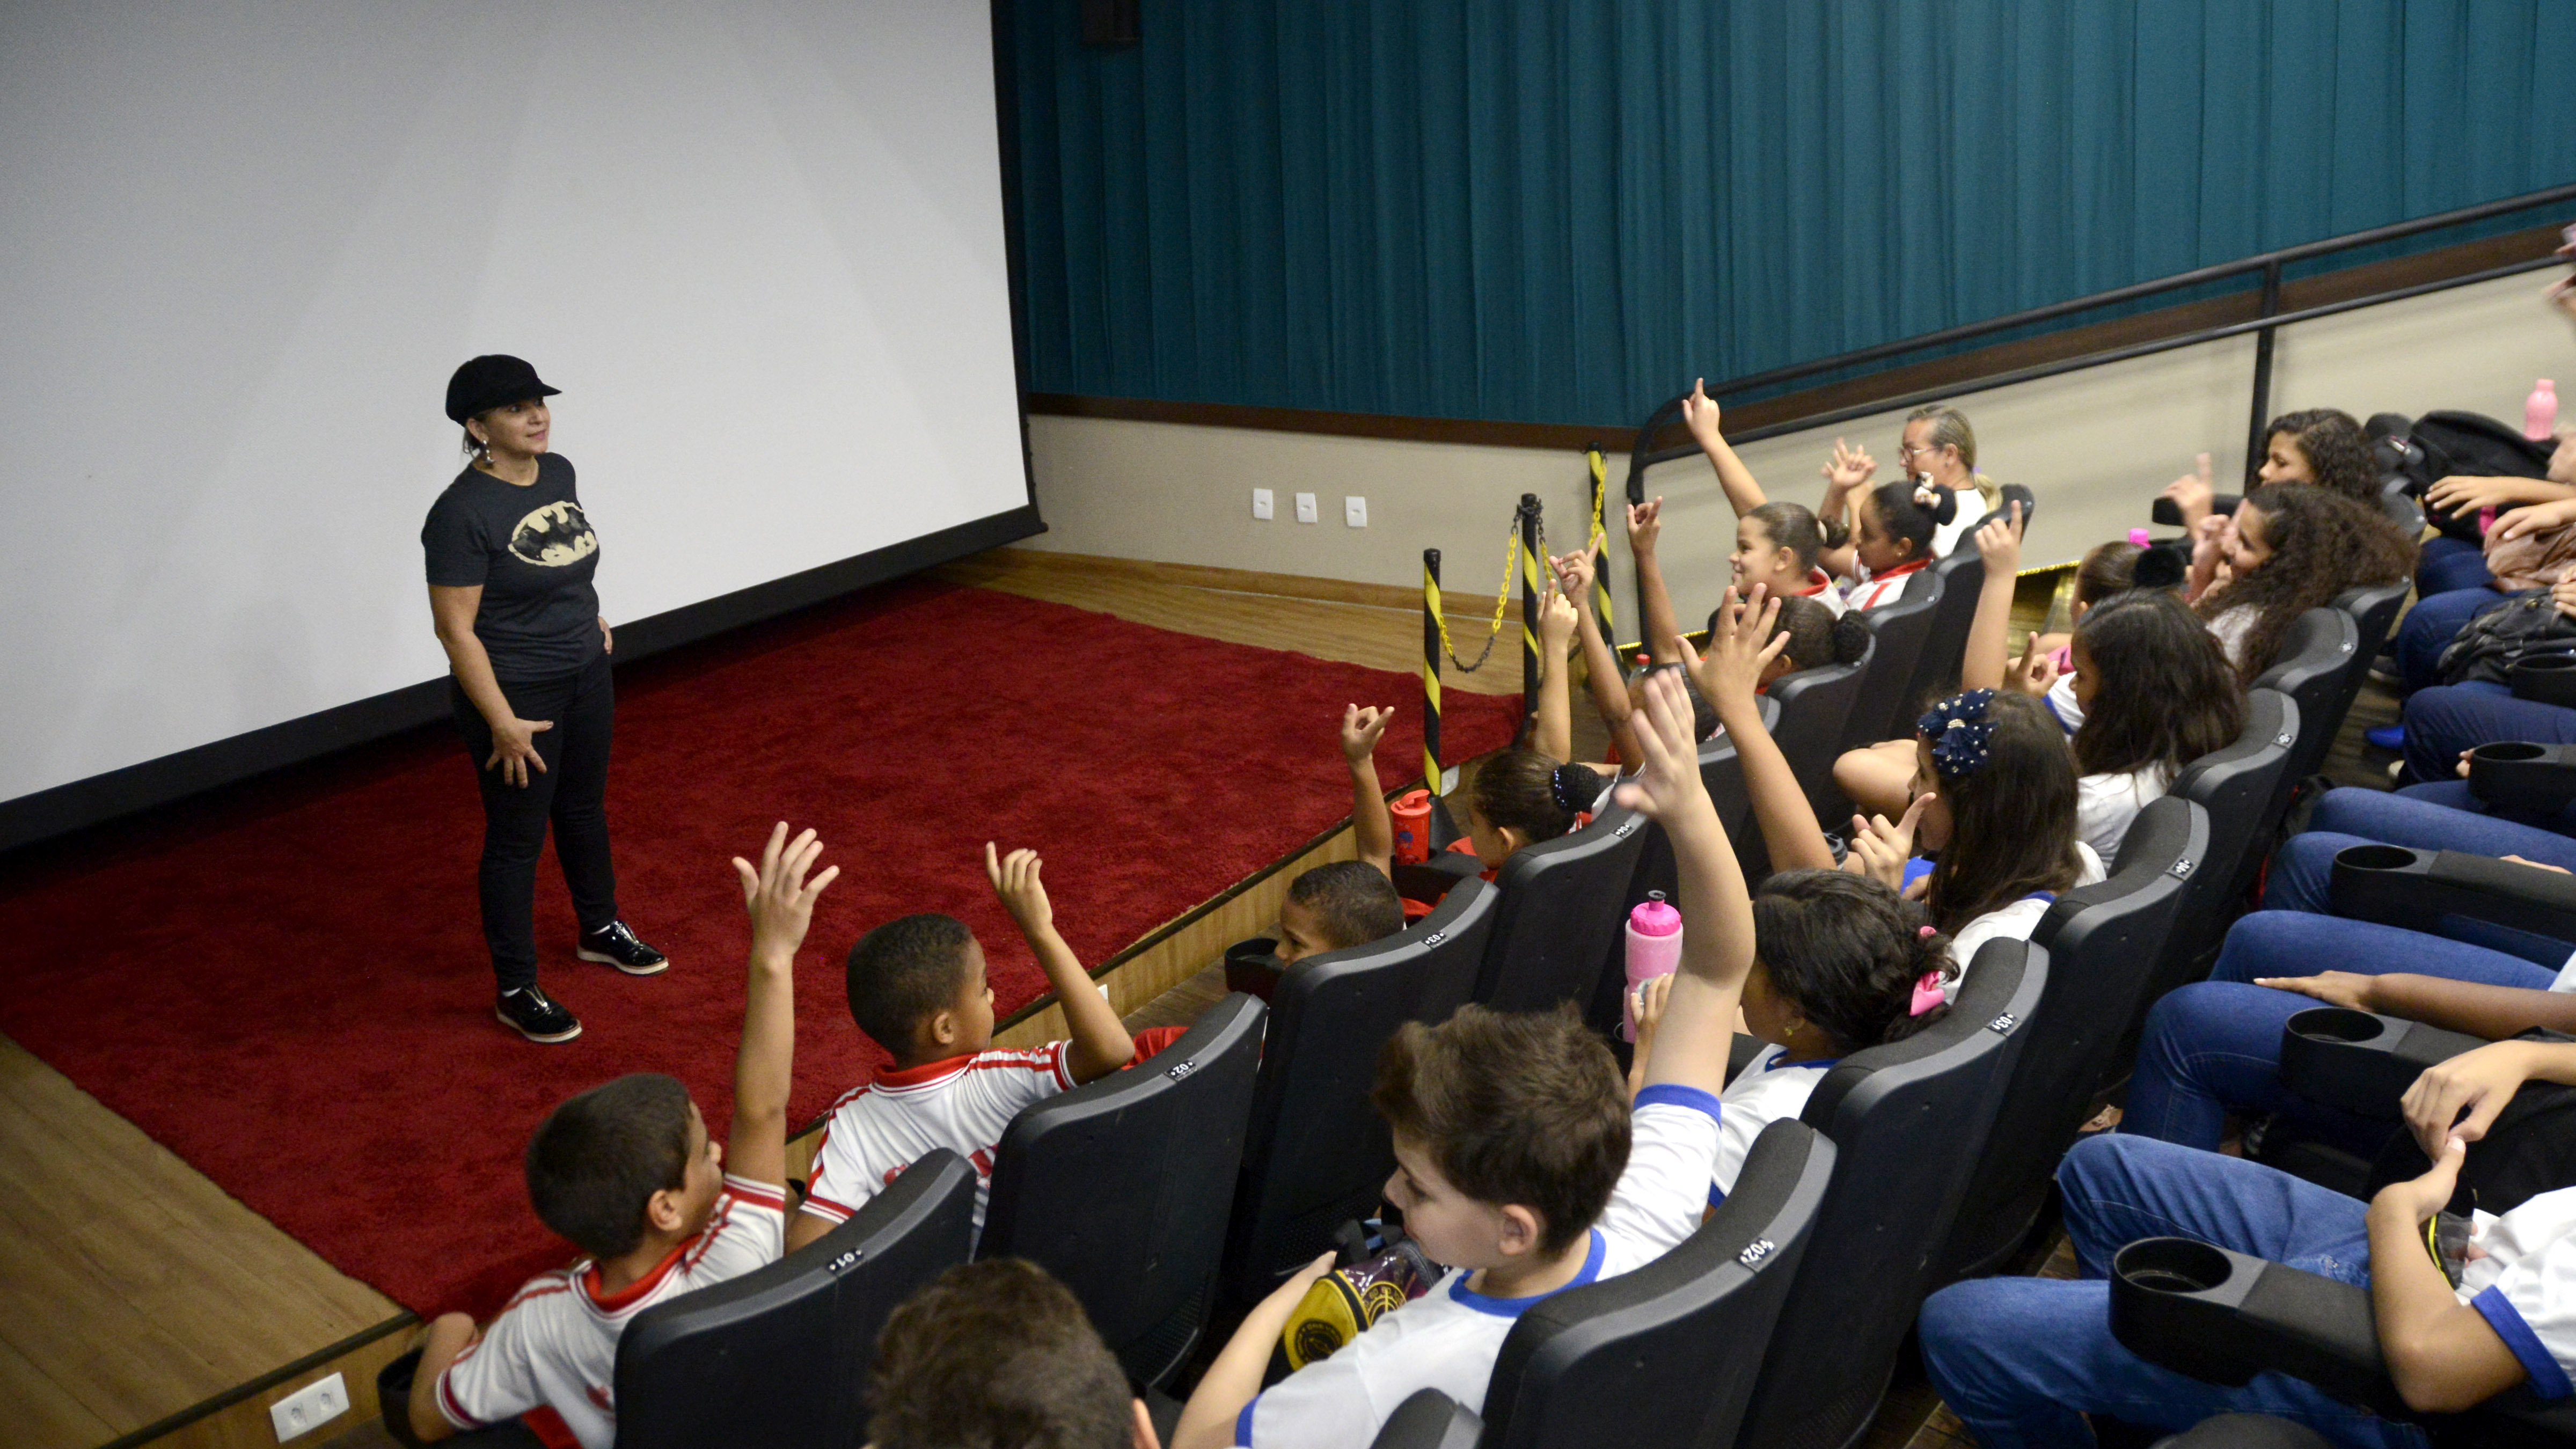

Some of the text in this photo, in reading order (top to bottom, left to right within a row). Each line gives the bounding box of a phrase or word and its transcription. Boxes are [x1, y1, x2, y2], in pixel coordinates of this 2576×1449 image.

[1428, 934, 1441, 943] 03
[1995, 1016, 2012, 1028] 03
[1173, 1063, 1189, 1074] 02
[1743, 1243, 1766, 1262] 02
[836, 1252, 855, 1267] 01
